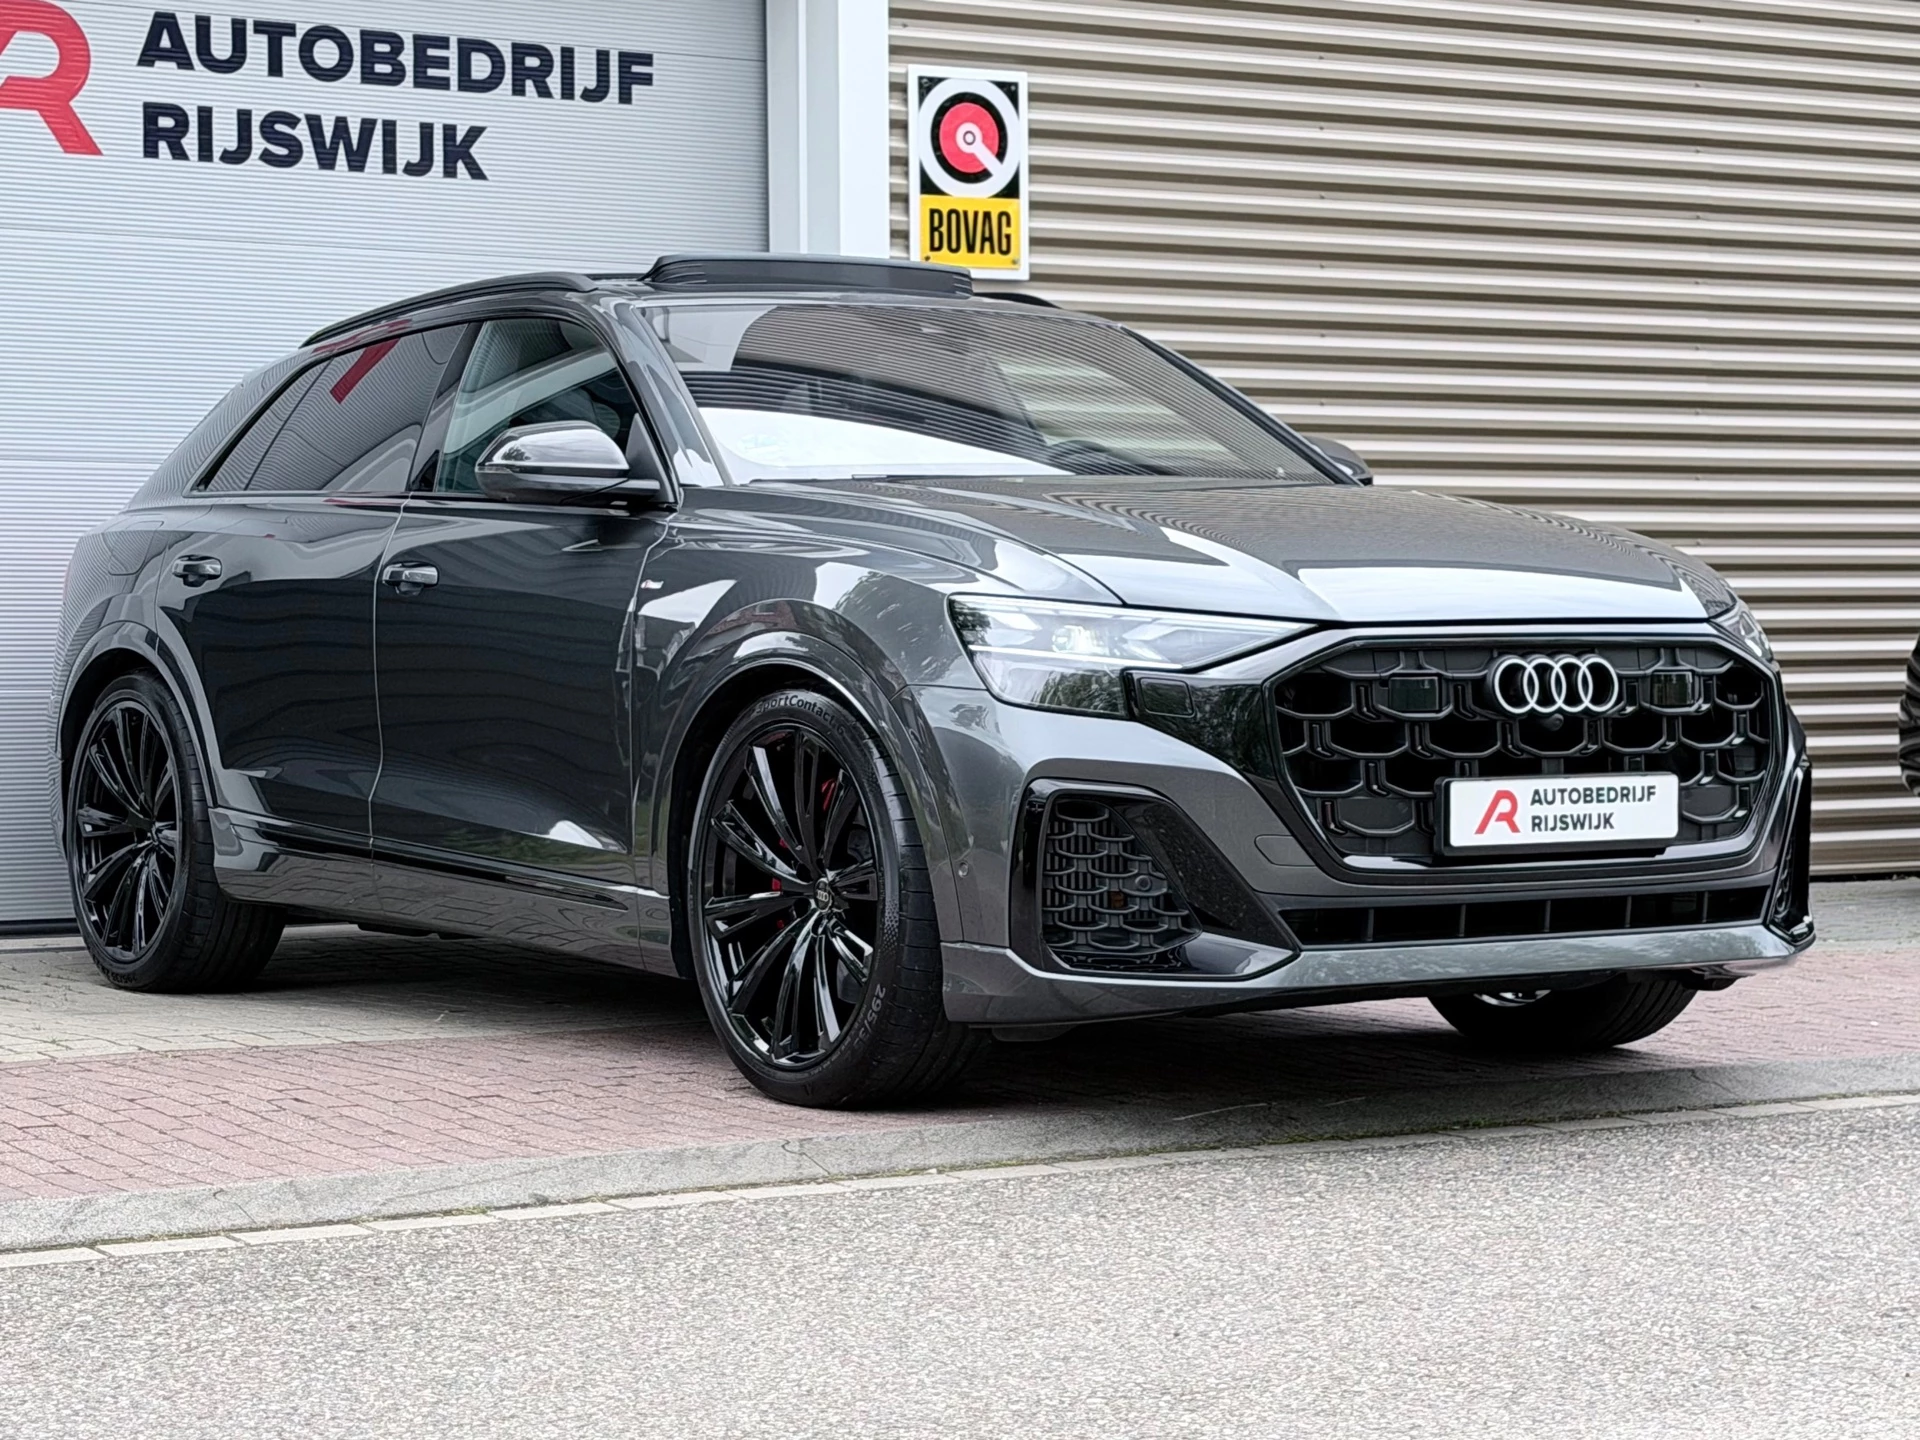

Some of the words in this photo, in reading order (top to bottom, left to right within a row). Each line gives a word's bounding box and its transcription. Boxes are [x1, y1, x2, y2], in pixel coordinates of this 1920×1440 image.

[136, 11, 655, 105] AUTOBEDRIJF
[142, 101, 489, 181] RIJSWIJK
[928, 208, 1012, 256] BOVAG
[1530, 785, 1657, 807] AUTOBEDRIJF
[1530, 812, 1615, 833] RIJSWIJK
